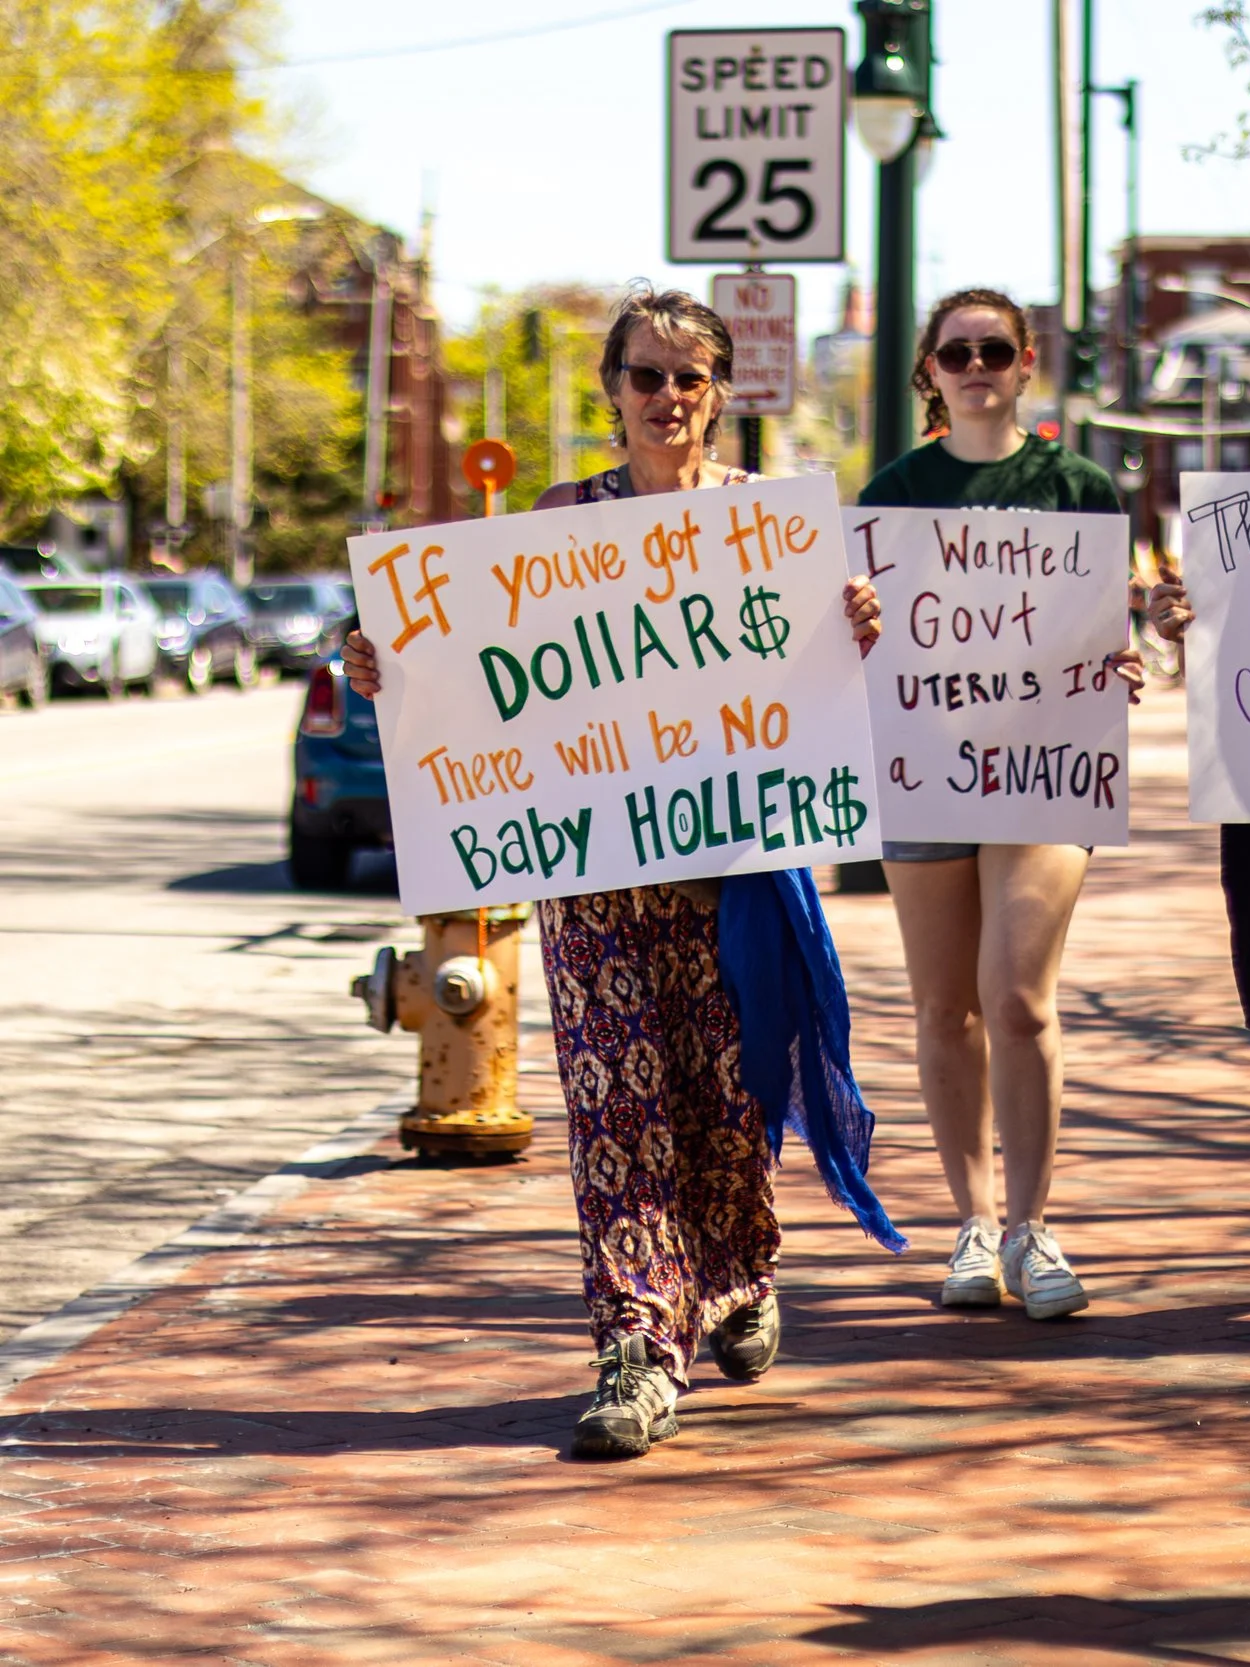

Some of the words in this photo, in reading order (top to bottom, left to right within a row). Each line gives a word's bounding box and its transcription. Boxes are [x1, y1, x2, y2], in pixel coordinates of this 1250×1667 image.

[681, 56, 832, 91] SPEED
[696, 105, 814, 139] LIMIT
[692, 160, 815, 241] 25
[368, 543, 452, 654] If
[491, 534, 626, 628] you've
[643, 509, 701, 604] got
[725, 501, 819, 575] the
[854, 517, 895, 579] I
[934, 519, 1090, 579] Wanted
[910, 591, 1037, 648] Govt
[1063, 659, 1107, 698] I'd
[418, 746, 534, 806] There
[554, 720, 629, 777] will
[648, 710, 699, 764] be
[719, 695, 789, 755] NO
[890, 756, 923, 791] a
[947, 739, 1120, 810] SENATOR
[450, 807, 592, 892] Baby
[625, 766, 868, 867] HOLLER$
